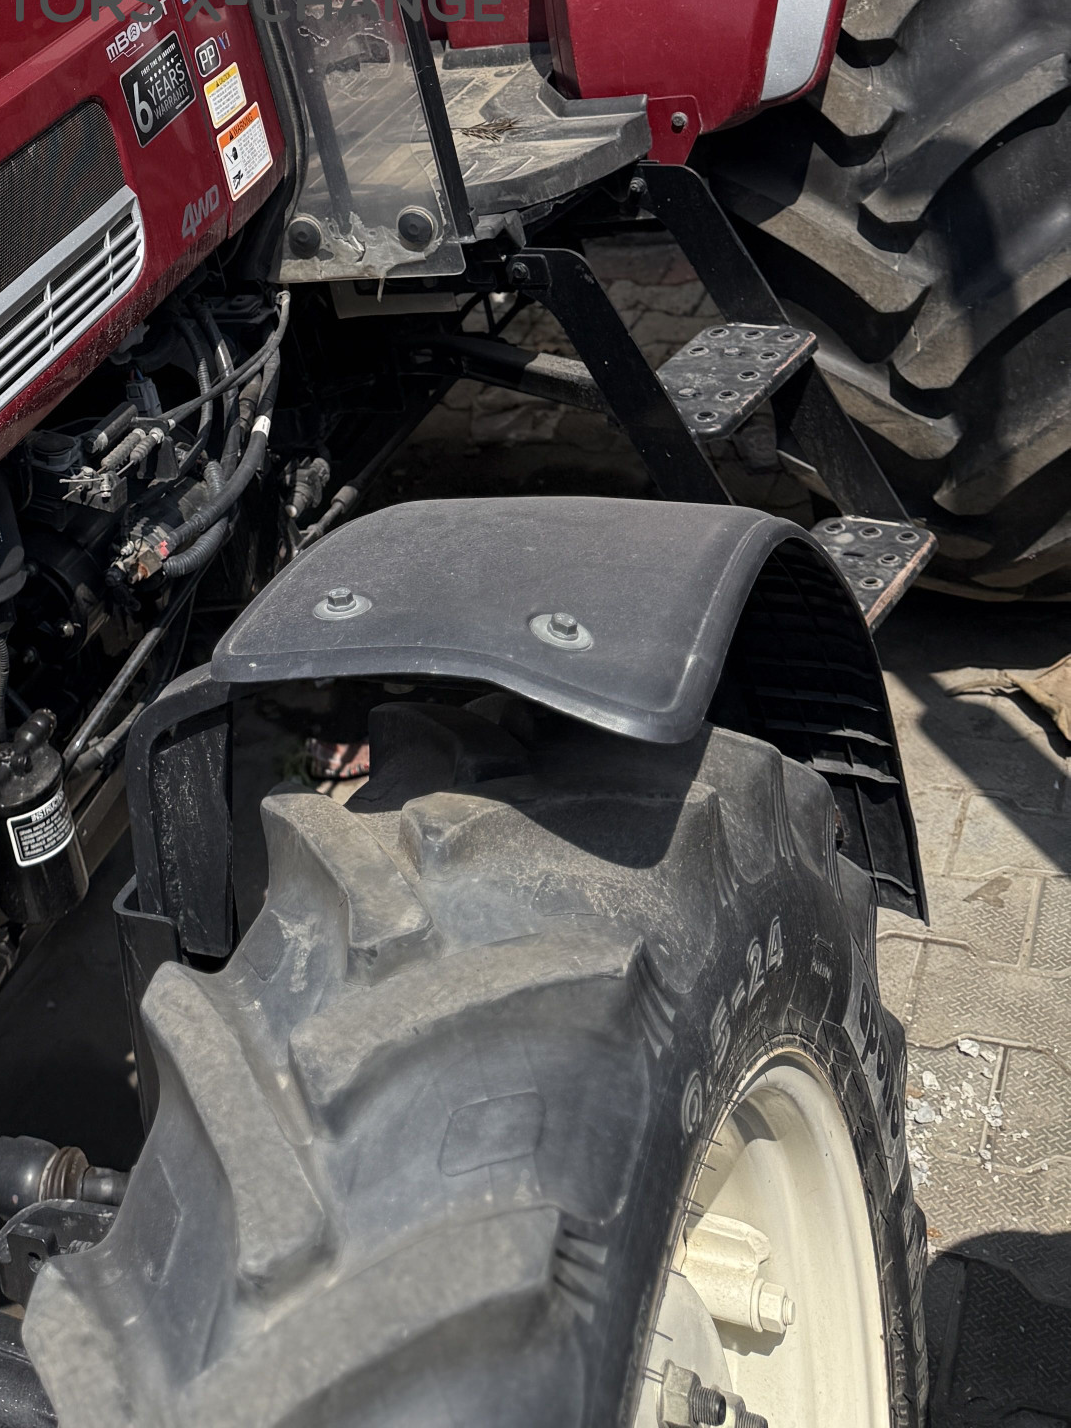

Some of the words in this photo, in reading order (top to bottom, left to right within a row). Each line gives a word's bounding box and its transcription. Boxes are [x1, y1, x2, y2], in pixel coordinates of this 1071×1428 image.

[198, 45, 216, 71] PP
[133, 81, 154, 134] 6
[153, 81, 189, 120] WARRANTY
[181, 184, 220, 240] 4WD
